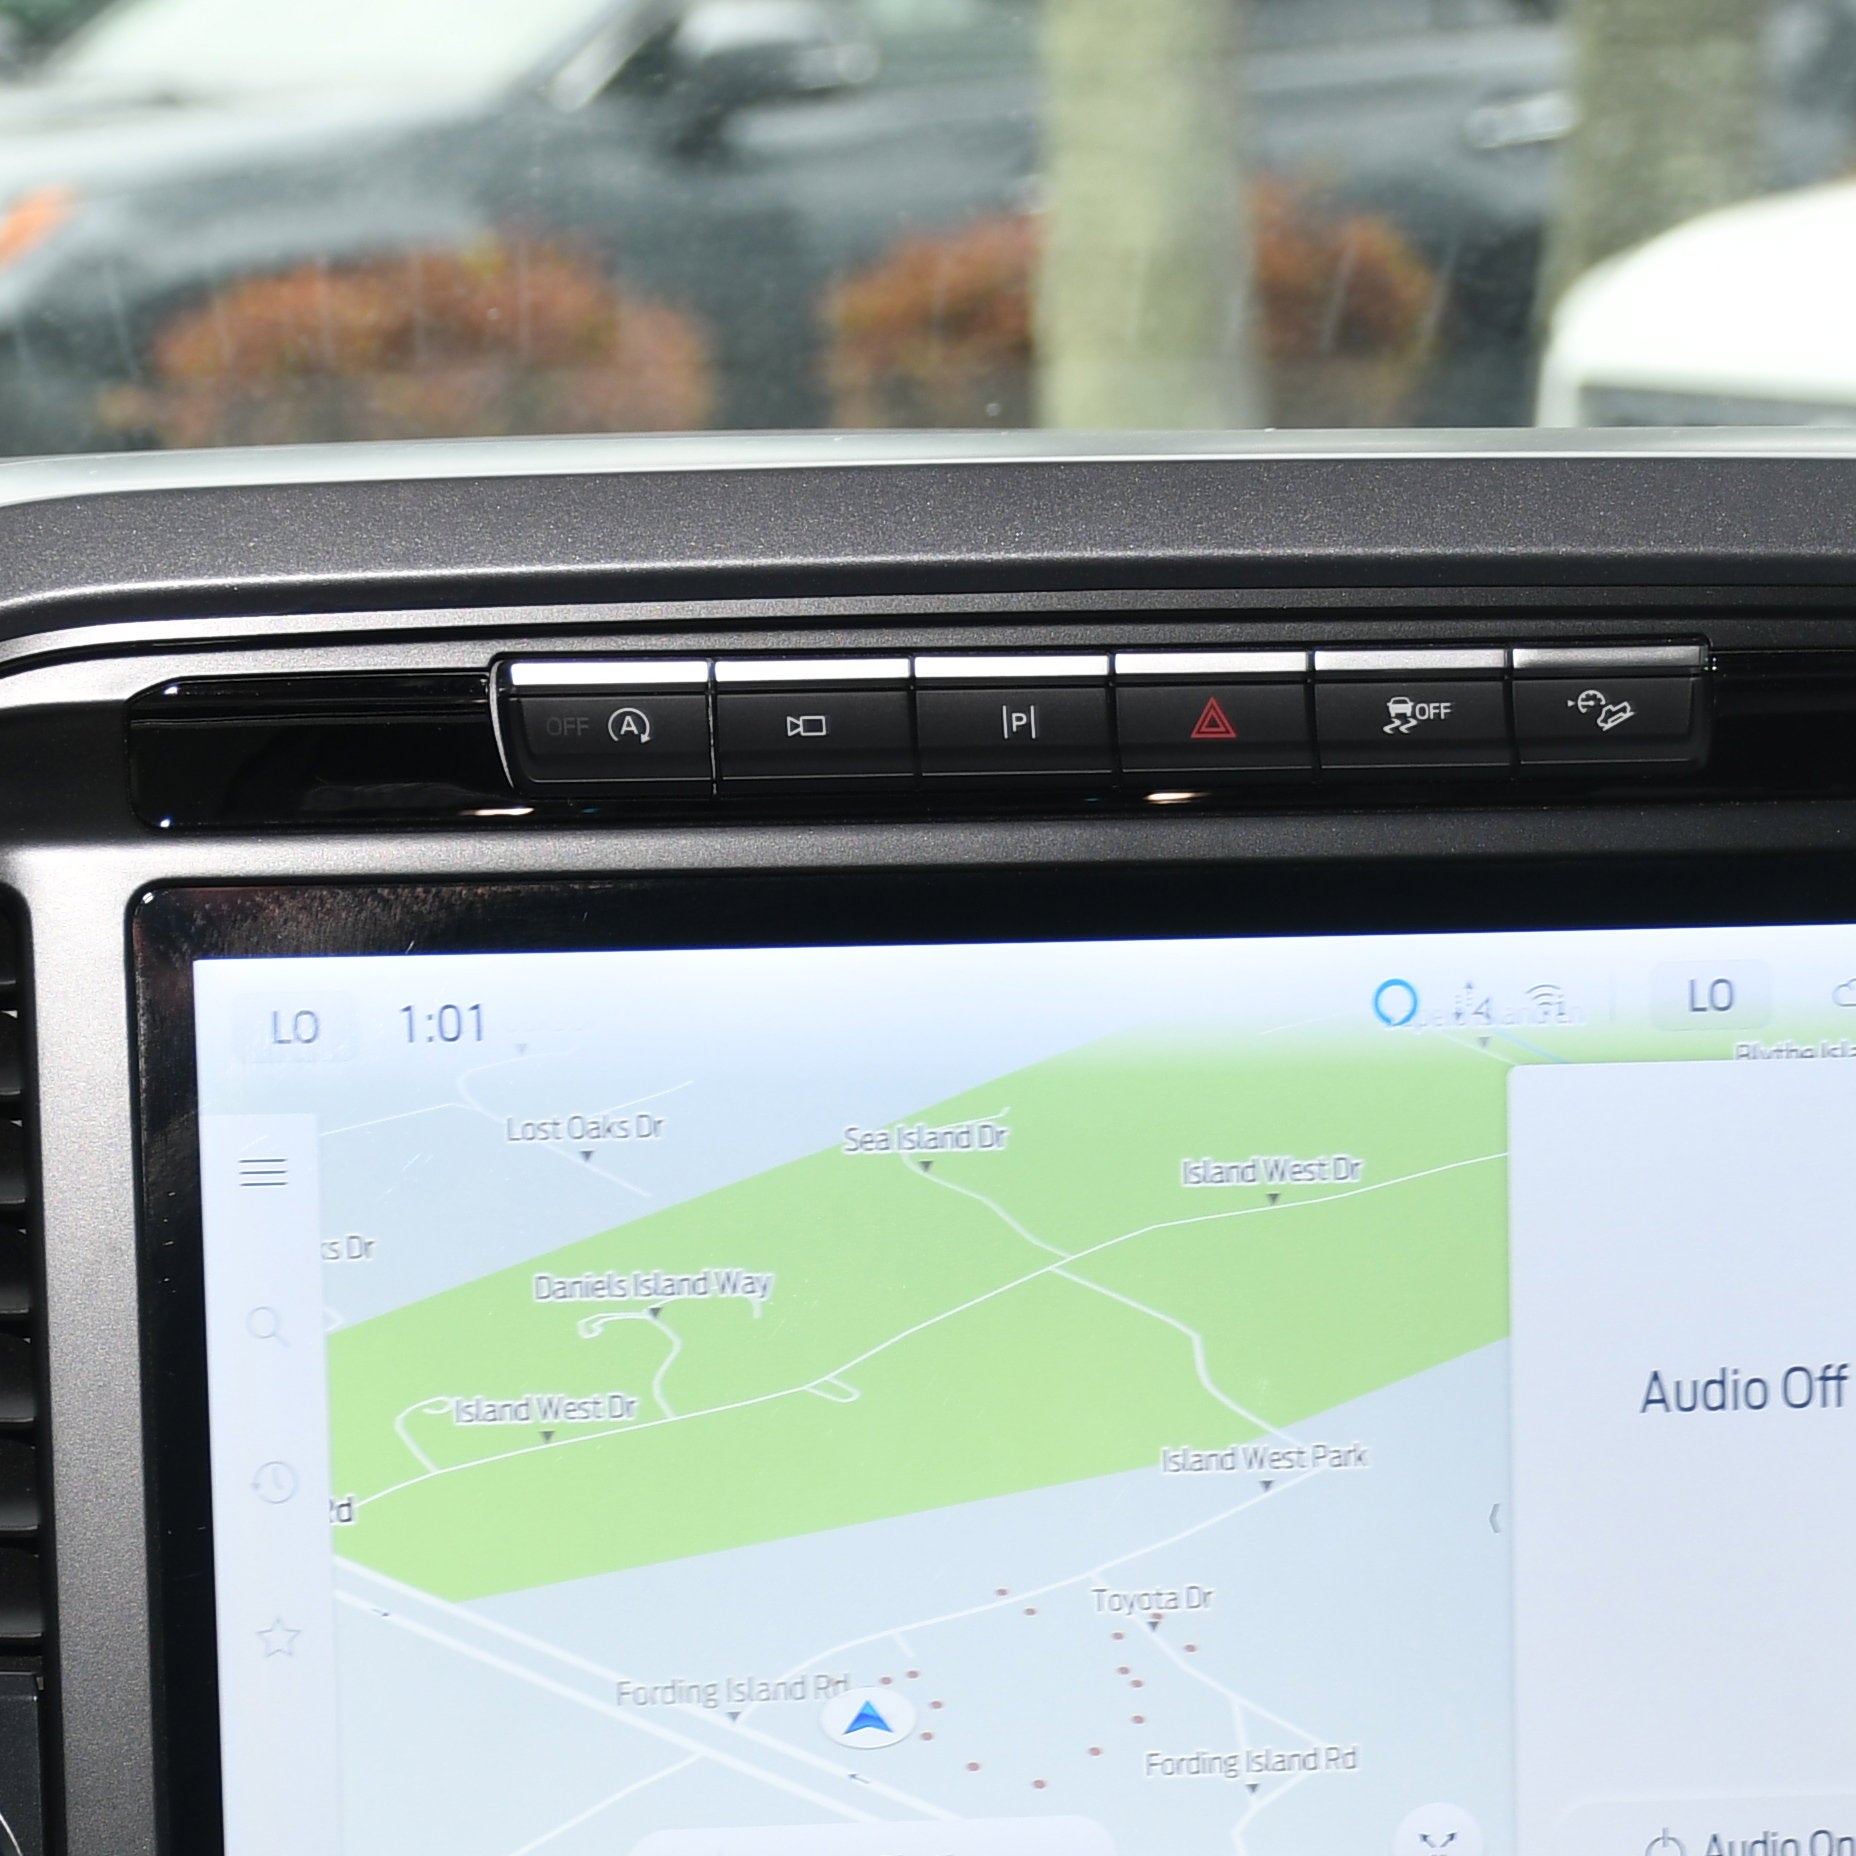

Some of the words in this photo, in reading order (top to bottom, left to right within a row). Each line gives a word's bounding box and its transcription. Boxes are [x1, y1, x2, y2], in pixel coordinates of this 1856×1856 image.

[1415, 701, 1452, 720] OFF
[1688, 979, 1735, 1013] LO
[271, 1009, 319, 1045] LO
[399, 1003, 486, 1043] 1:01
[507, 1117, 562, 1142] Lost
[569, 1116, 631, 1140] Oaks
[638, 1116, 663, 1140] Dr
[845, 1126, 891, 1152] Sea
[898, 1125, 971, 1150] Island
[978, 1124, 1006, 1149] Dr
[1182, 1159, 1258, 1184] Island
[1263, 1159, 1328, 1183] West
[1334, 1157, 1362, 1181] Dr
[347, 1237, 374, 1259] Dr
[535, 1275, 627, 1300] Daniels
[634, 1273, 710, 1298] Island
[717, 1272, 773, 1299] Way
[1641, 1368, 1769, 1413] Audio
[1781, 1363, 1851, 1409] Off
[455, 1398, 530, 1424] Island
[538, 1397, 602, 1422] West
[609, 1396, 637, 1421] Dr
[1163, 1448, 1236, 1473] Island
[1242, 1446, 1306, 1470] West
[1313, 1445, 1367, 1469] Park
[1093, 1588, 1180, 1616] Toyota
[1187, 1587, 1213, 1612] Dr
[618, 1680, 718, 1710] Fording
[727, 1677, 806, 1704] Island
[1146, 1752, 1238, 1781] Fording
[1246, 1750, 1318, 1774] Island
[1325, 1746, 1357, 1770] Rd
